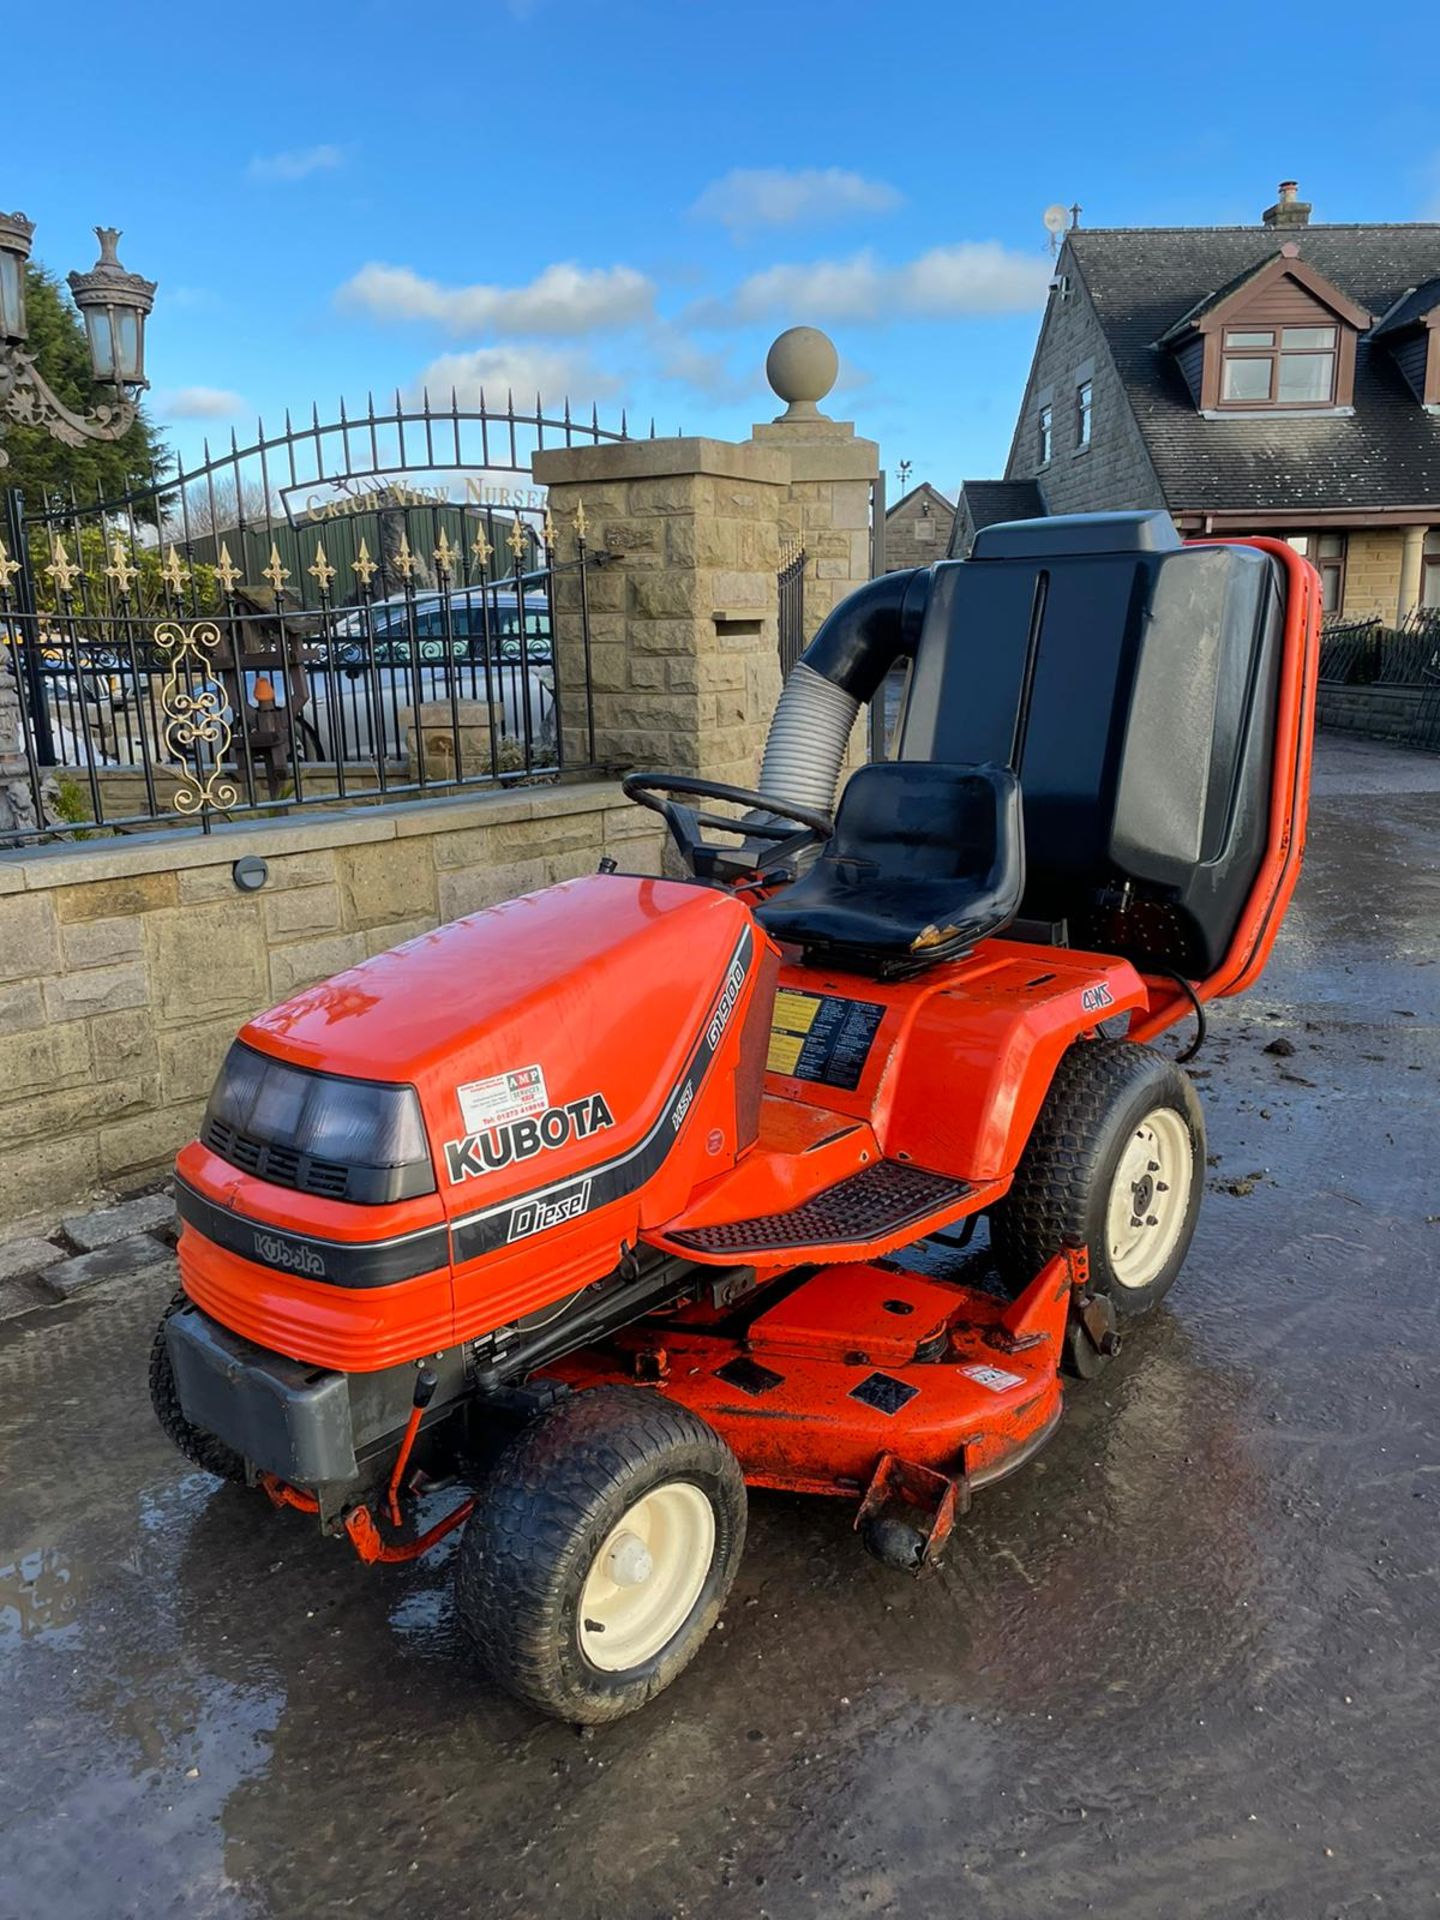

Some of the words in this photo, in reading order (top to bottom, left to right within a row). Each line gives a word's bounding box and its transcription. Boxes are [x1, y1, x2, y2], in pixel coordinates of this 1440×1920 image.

[706, 960, 745, 1051] G1900
[1082, 982, 1114, 1011] 4WS
[509, 1070, 539, 1088] AMP
[444, 1092, 616, 1185] KUBOTA
[507, 1179, 592, 1243] Diesel
[253, 1232, 326, 1276] Kubota
